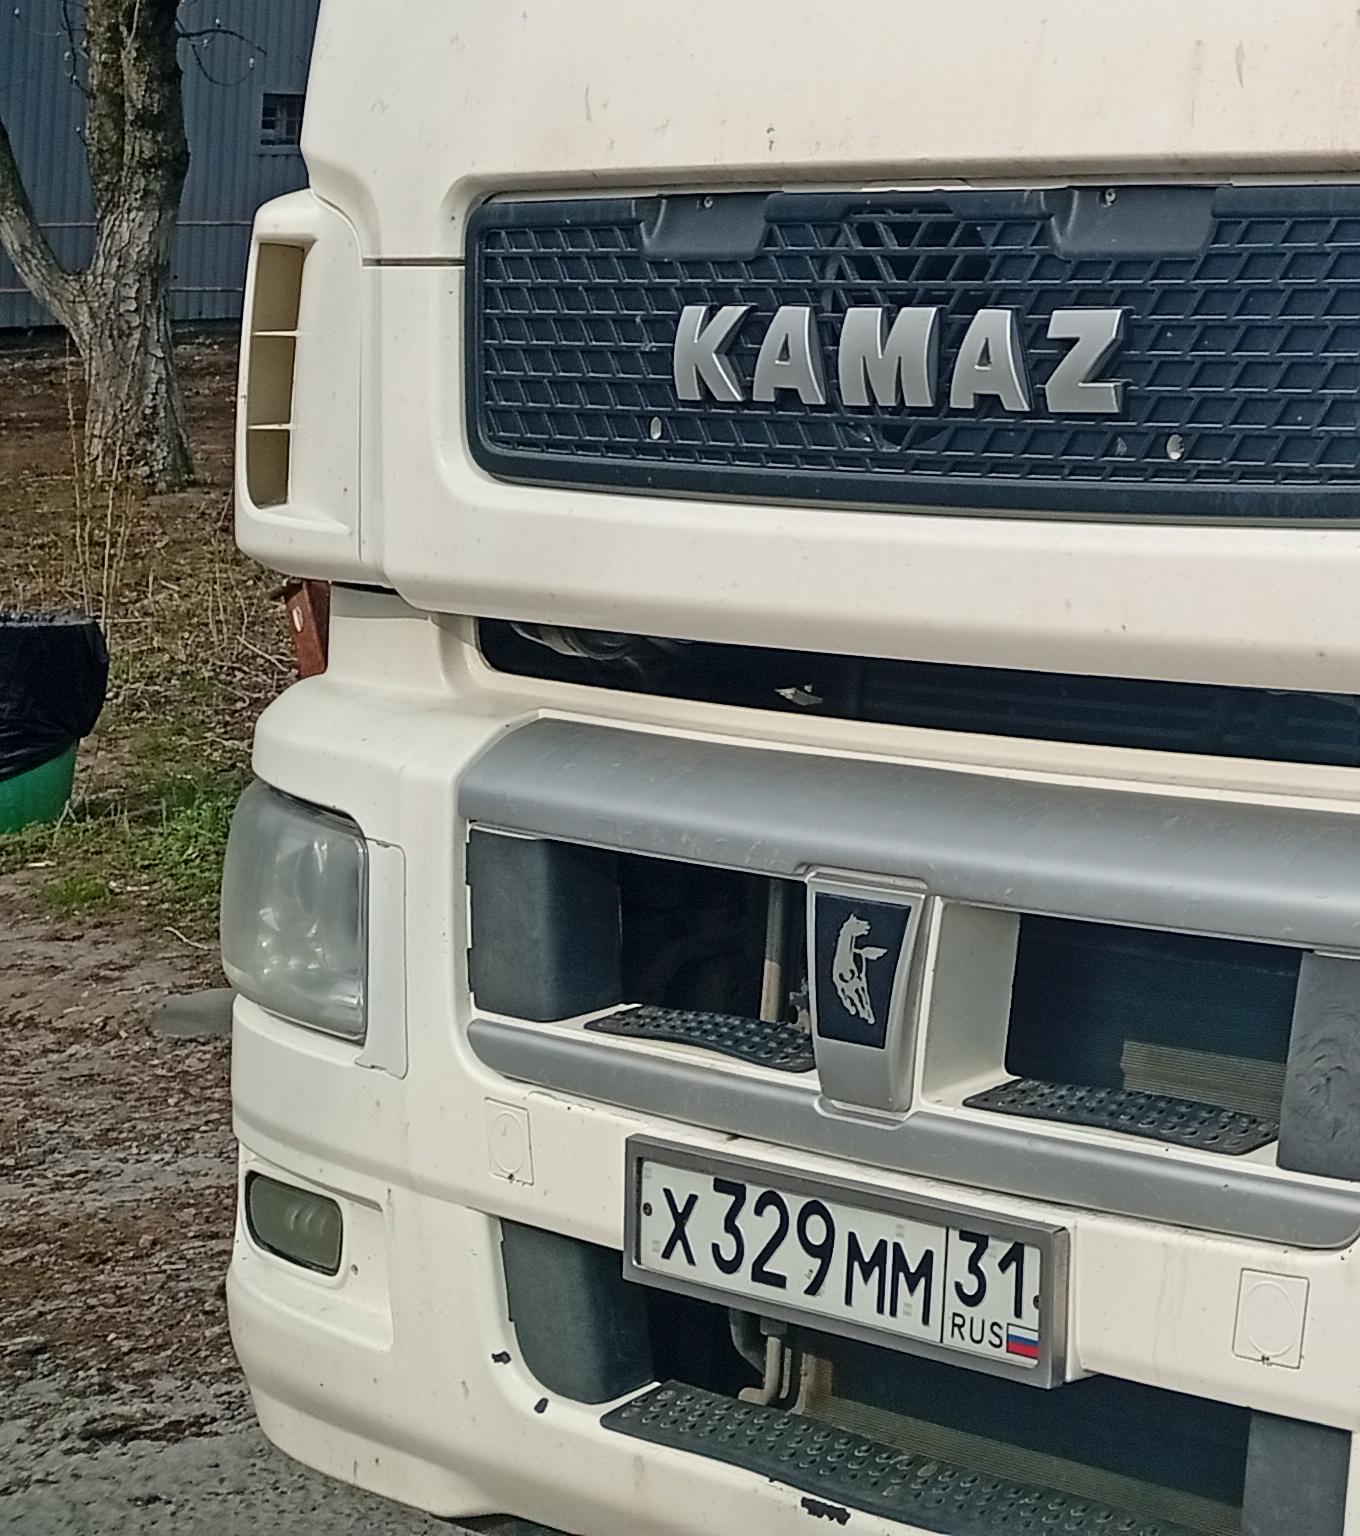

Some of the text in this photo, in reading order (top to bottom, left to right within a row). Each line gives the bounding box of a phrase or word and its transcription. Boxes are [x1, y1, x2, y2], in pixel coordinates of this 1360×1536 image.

[673, 304, 1128, 413] KAMAZ
[954, 1229, 1025, 1319] 31
[950, 1312, 1004, 1350] RUS
